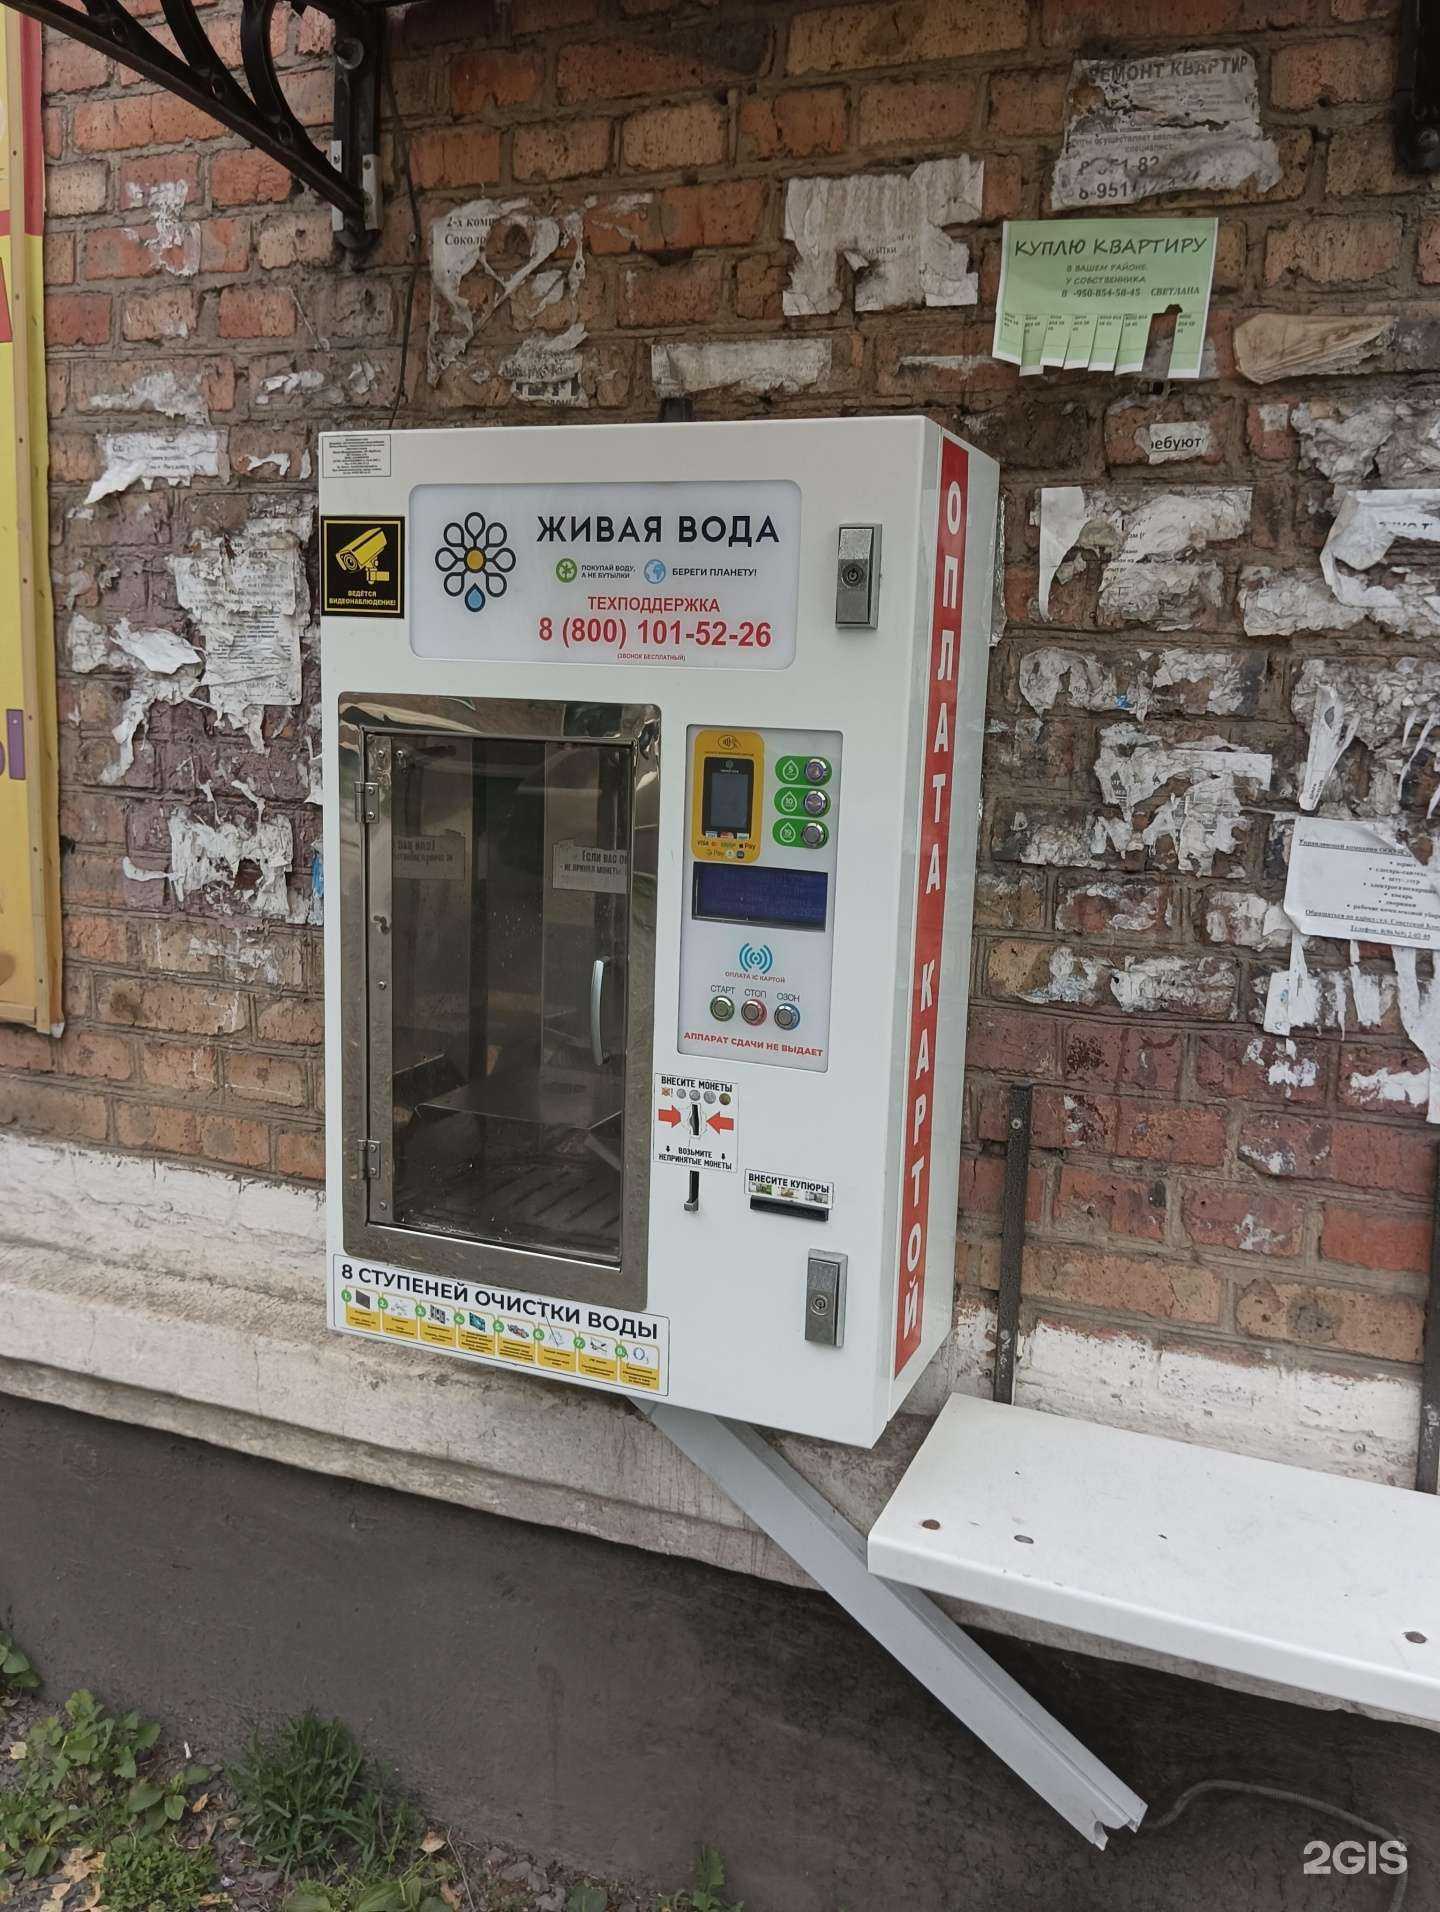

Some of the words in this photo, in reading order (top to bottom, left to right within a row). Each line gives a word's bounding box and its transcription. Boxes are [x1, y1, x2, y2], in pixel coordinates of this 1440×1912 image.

[1171, 56, 1248, 77] КВАРТИР
[1015, 239, 1086, 256] КУПЛЮ
[1093, 238, 1207, 254] КВАРТИРУ
[536, 515, 662, 543] ЖИВАЯ
[678, 515, 780, 547] ВОДА
[581, 564, 614, 572] ПОКУПАЙ
[615, 565, 636, 573] ВОДУ,
[598, 572, 630, 580] БУТЫЛКИ
[672, 567, 707, 577] БЕРЕГИ
[710, 568, 757, 577] ПЛАНЕТУ!
[588, 596, 720, 613] ТЕХПОДДЕРЖКА
[539, 617, 552, 641] 8
[563, 617, 627, 649] (800)
[637, 619, 772, 648] 101-52-26
[925, 481, 962, 894] ОПЛАТА
[725, 971, 751, 979] ОПЛАТА
[710, 984, 736, 995] СТАРТ
[744, 988, 767, 998] СТОП
[777, 992, 800, 1002] ОЗОН
[684, 1032, 729, 1044] АППАРАТ
[731, 1038, 764, 1049] СДАЧИ
[766, 1043, 779, 1051] НЕ
[782, 1045, 824, 1057] ВЫДАЕТ
[661, 1076, 695, 1088] ВНЕСИТЕ
[698, 1081, 732, 1092] МОНЕТЫ
[678, 1147, 712, 1158] ВОЗЬМИТЕ
[903, 959, 935, 1340] КАРТОЙ
[659, 1153, 702, 1165] НЕПРИНЯТЫЕ
[704, 1159, 732, 1170] МОНЕТЫ
[748, 1173, 788, 1186] ВНЕСИТЕ
[790, 1180, 829, 1193] КУПЮРЫ
[341, 1264, 353, 1280] 8
[359, 1267, 468, 1303] СТУПЕНЕЙ
[475, 1290, 580, 1324] ОЧИСТКИ
[588, 1311, 657, 1339] ВОДЫ
